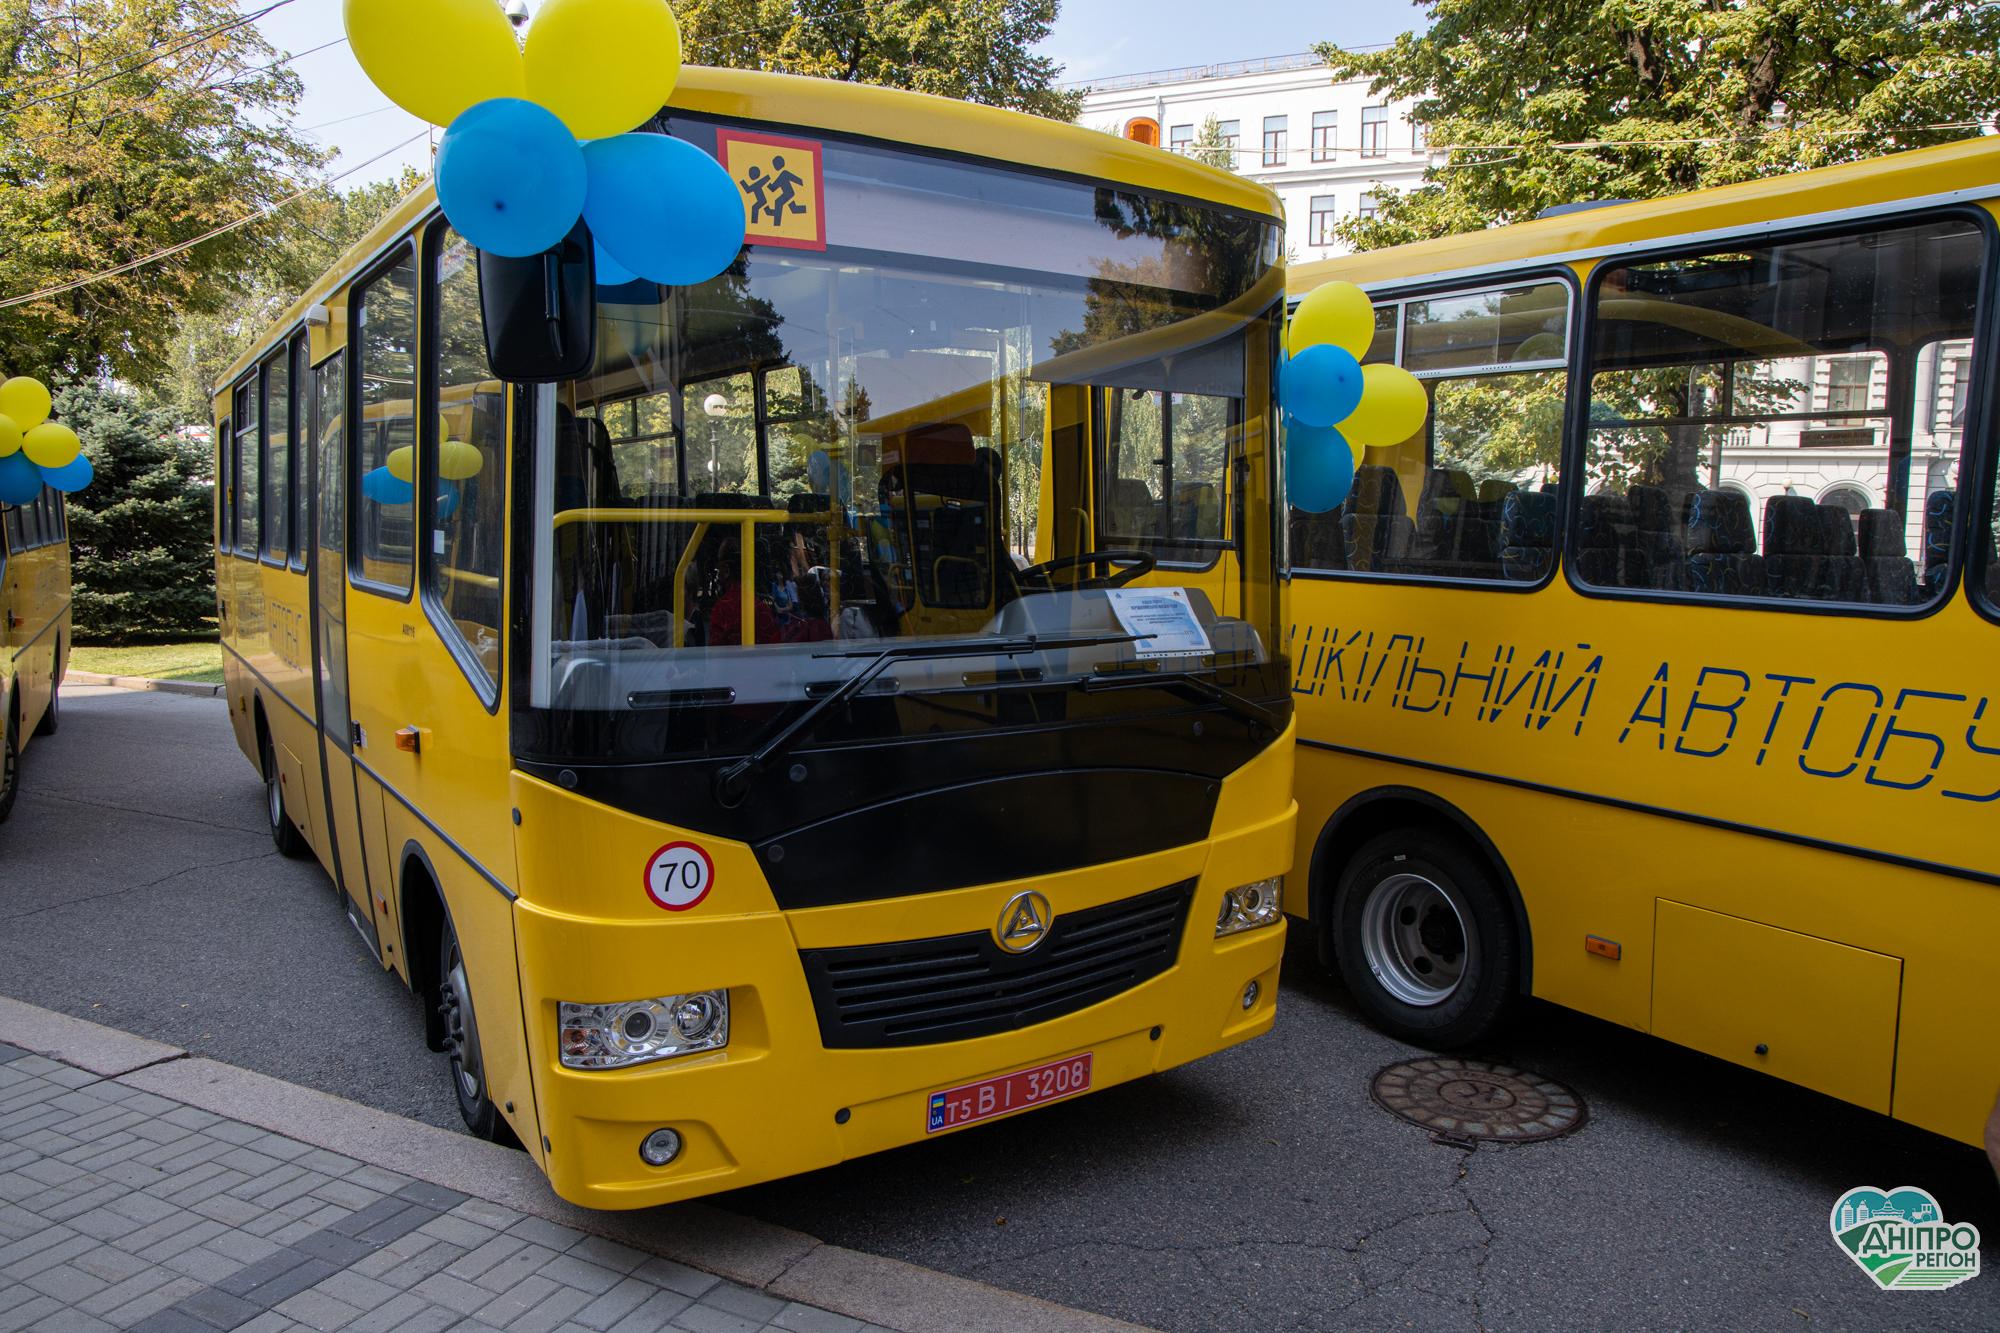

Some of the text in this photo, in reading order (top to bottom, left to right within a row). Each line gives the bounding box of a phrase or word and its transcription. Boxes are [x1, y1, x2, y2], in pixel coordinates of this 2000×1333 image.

[659, 860, 701, 893] 70
[1025, 1061, 1085, 1102] 3208
[931, 1116, 943, 1126] UA
